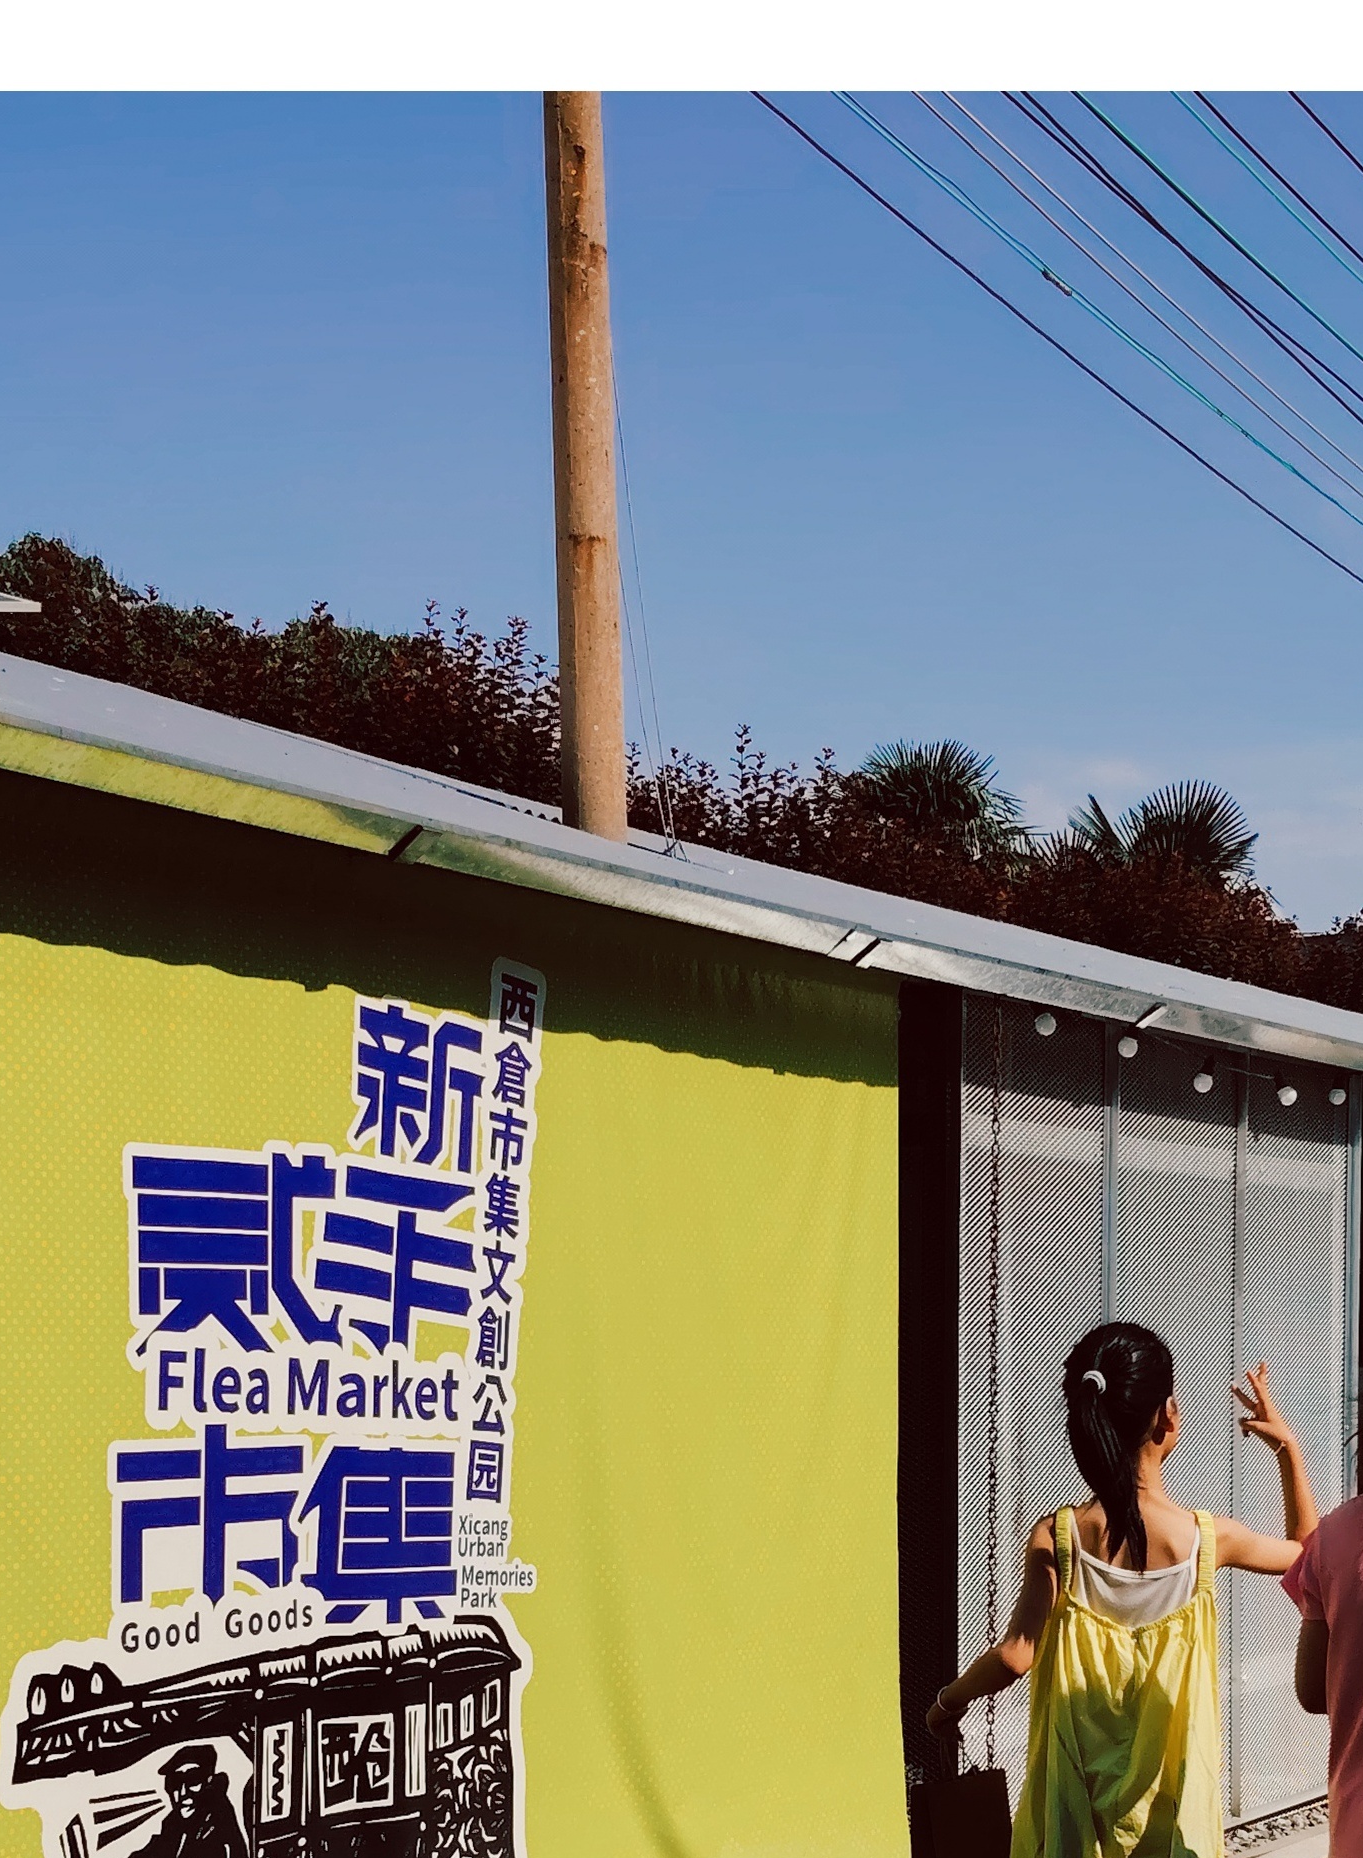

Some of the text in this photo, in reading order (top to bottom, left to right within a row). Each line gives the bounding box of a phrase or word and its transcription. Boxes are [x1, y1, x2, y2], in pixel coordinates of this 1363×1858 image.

[354, 1004, 485, 1173] 新
[158, 1349, 460, 1421] Flea Market
[117, 1424, 458, 1624] 市集
[459, 1515, 509, 1541] Xicang
[458, 1536, 505, 1558] Urban
[462, 1565, 533, 1588] Memories
[461, 1587, 497, 1608] Park
[121, 1600, 314, 1653] Good Goods
